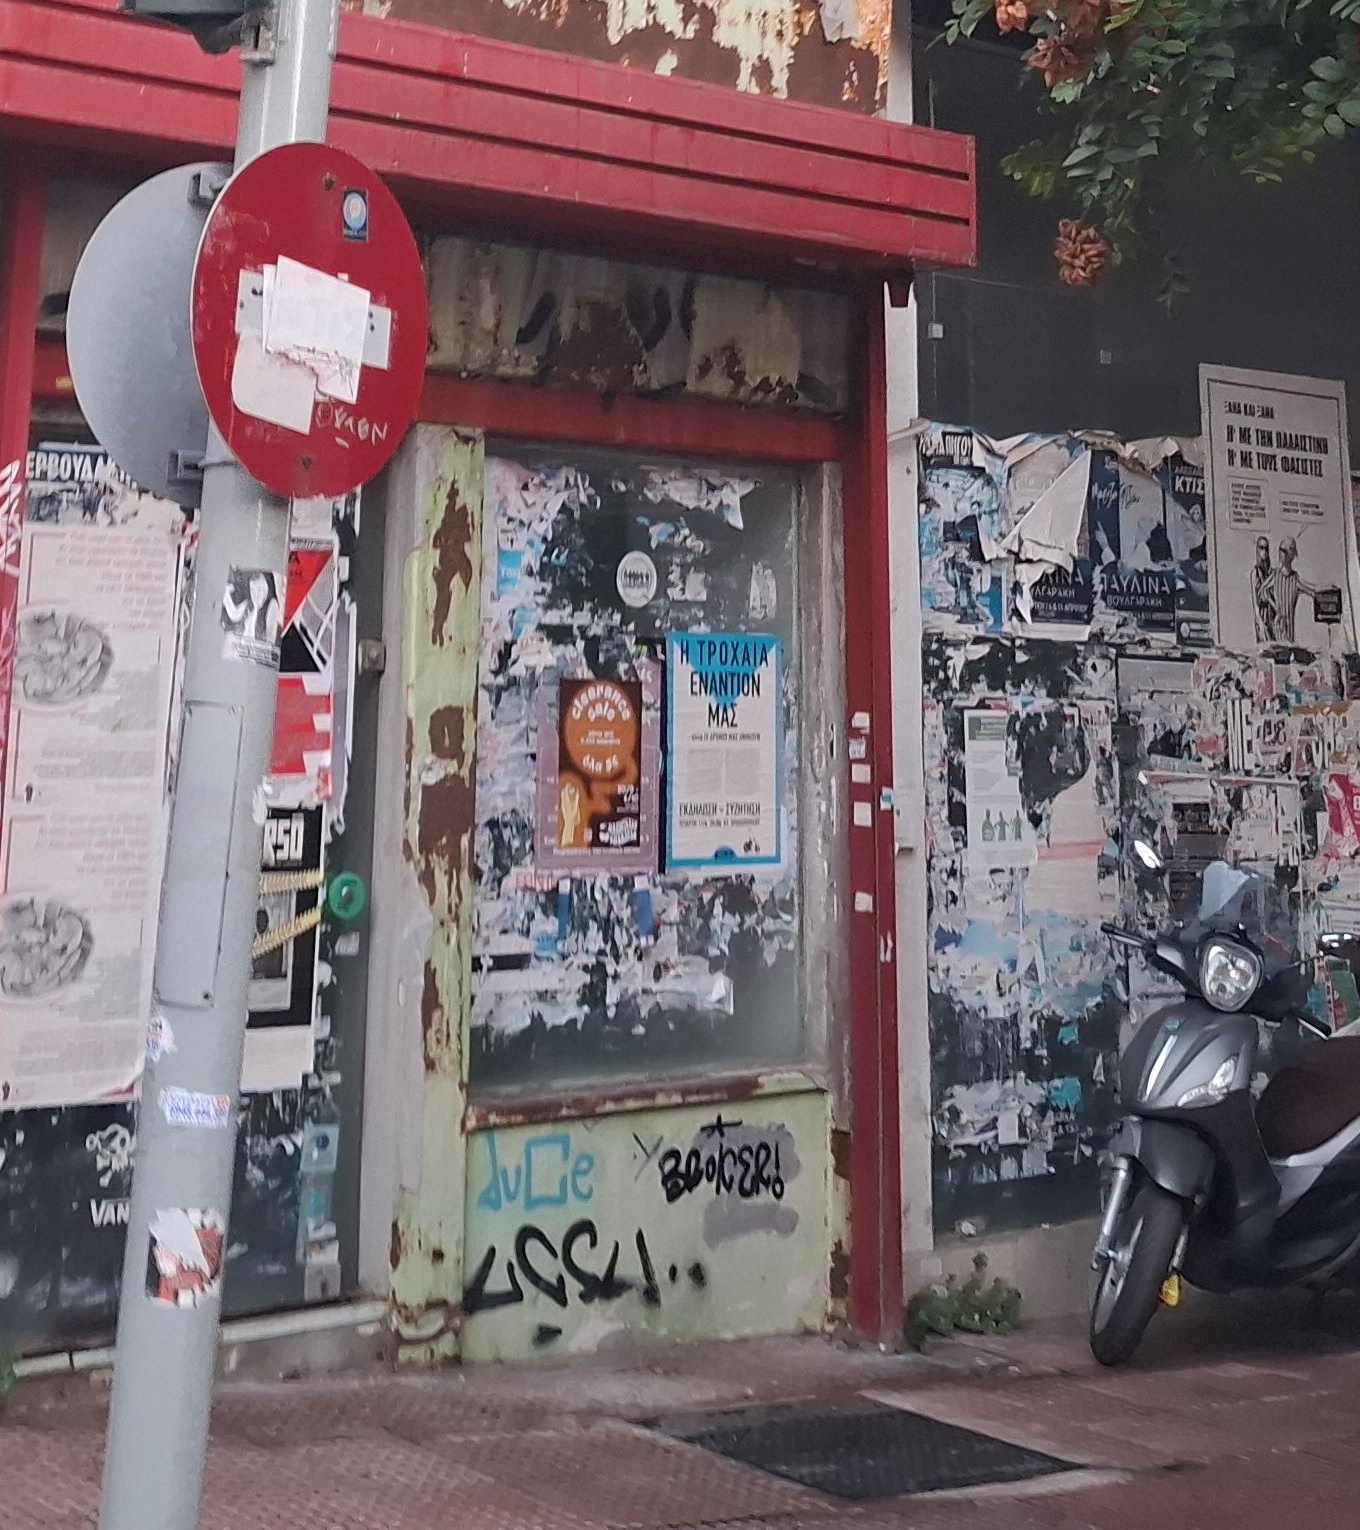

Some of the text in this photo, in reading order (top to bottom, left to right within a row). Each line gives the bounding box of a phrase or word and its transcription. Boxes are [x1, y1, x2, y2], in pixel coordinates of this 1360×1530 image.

[680, 639, 769, 667] Η ΤΡΟΧΑΙΑ
[690, 671, 760, 698] ΕΝΑΝΤΙΟΝ
[571, 684, 631, 721] clearance
[588, 702, 615, 722] sale
[708, 703, 738, 728] ΜΑΣ
